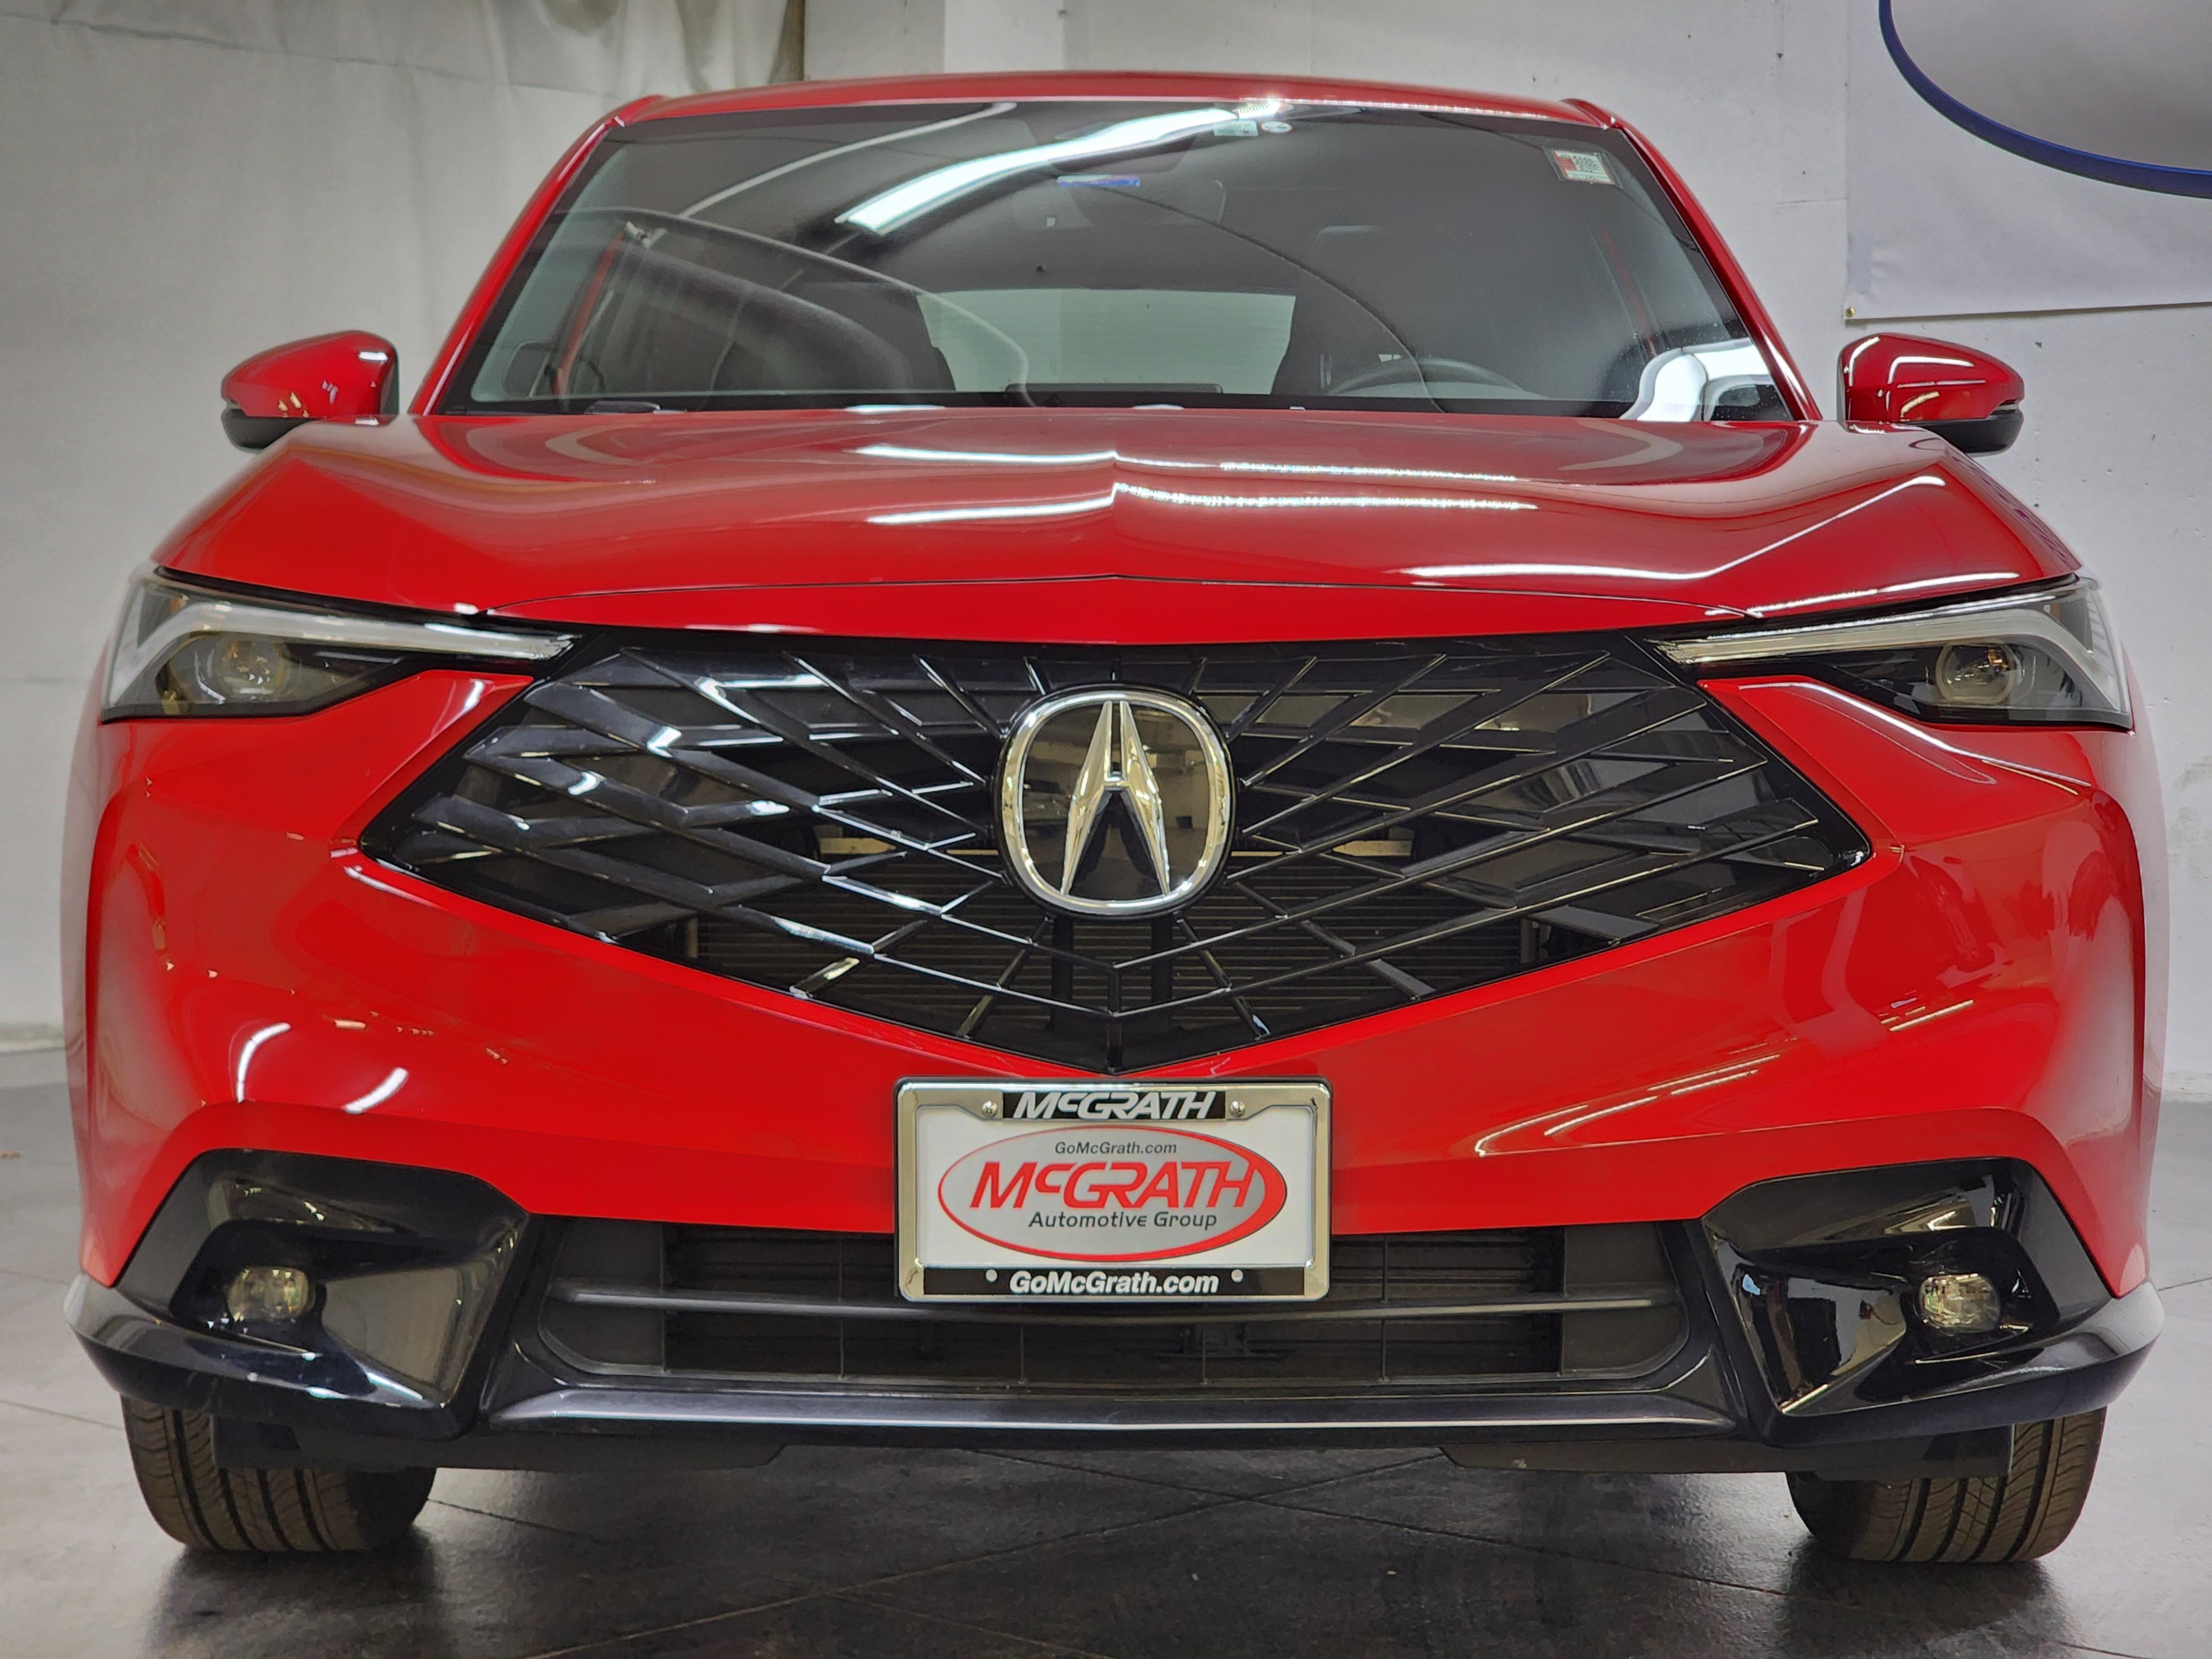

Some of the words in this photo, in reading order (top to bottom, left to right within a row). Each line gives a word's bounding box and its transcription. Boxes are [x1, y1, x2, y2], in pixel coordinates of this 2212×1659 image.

[1055, 1141, 1177, 1155] GoMcGrath.com
[1028, 1212, 1147, 1227] Automotive
[1154, 1212, 1217, 1230] Group
[1009, 1272, 1219, 1294] GoMcGrath.com
